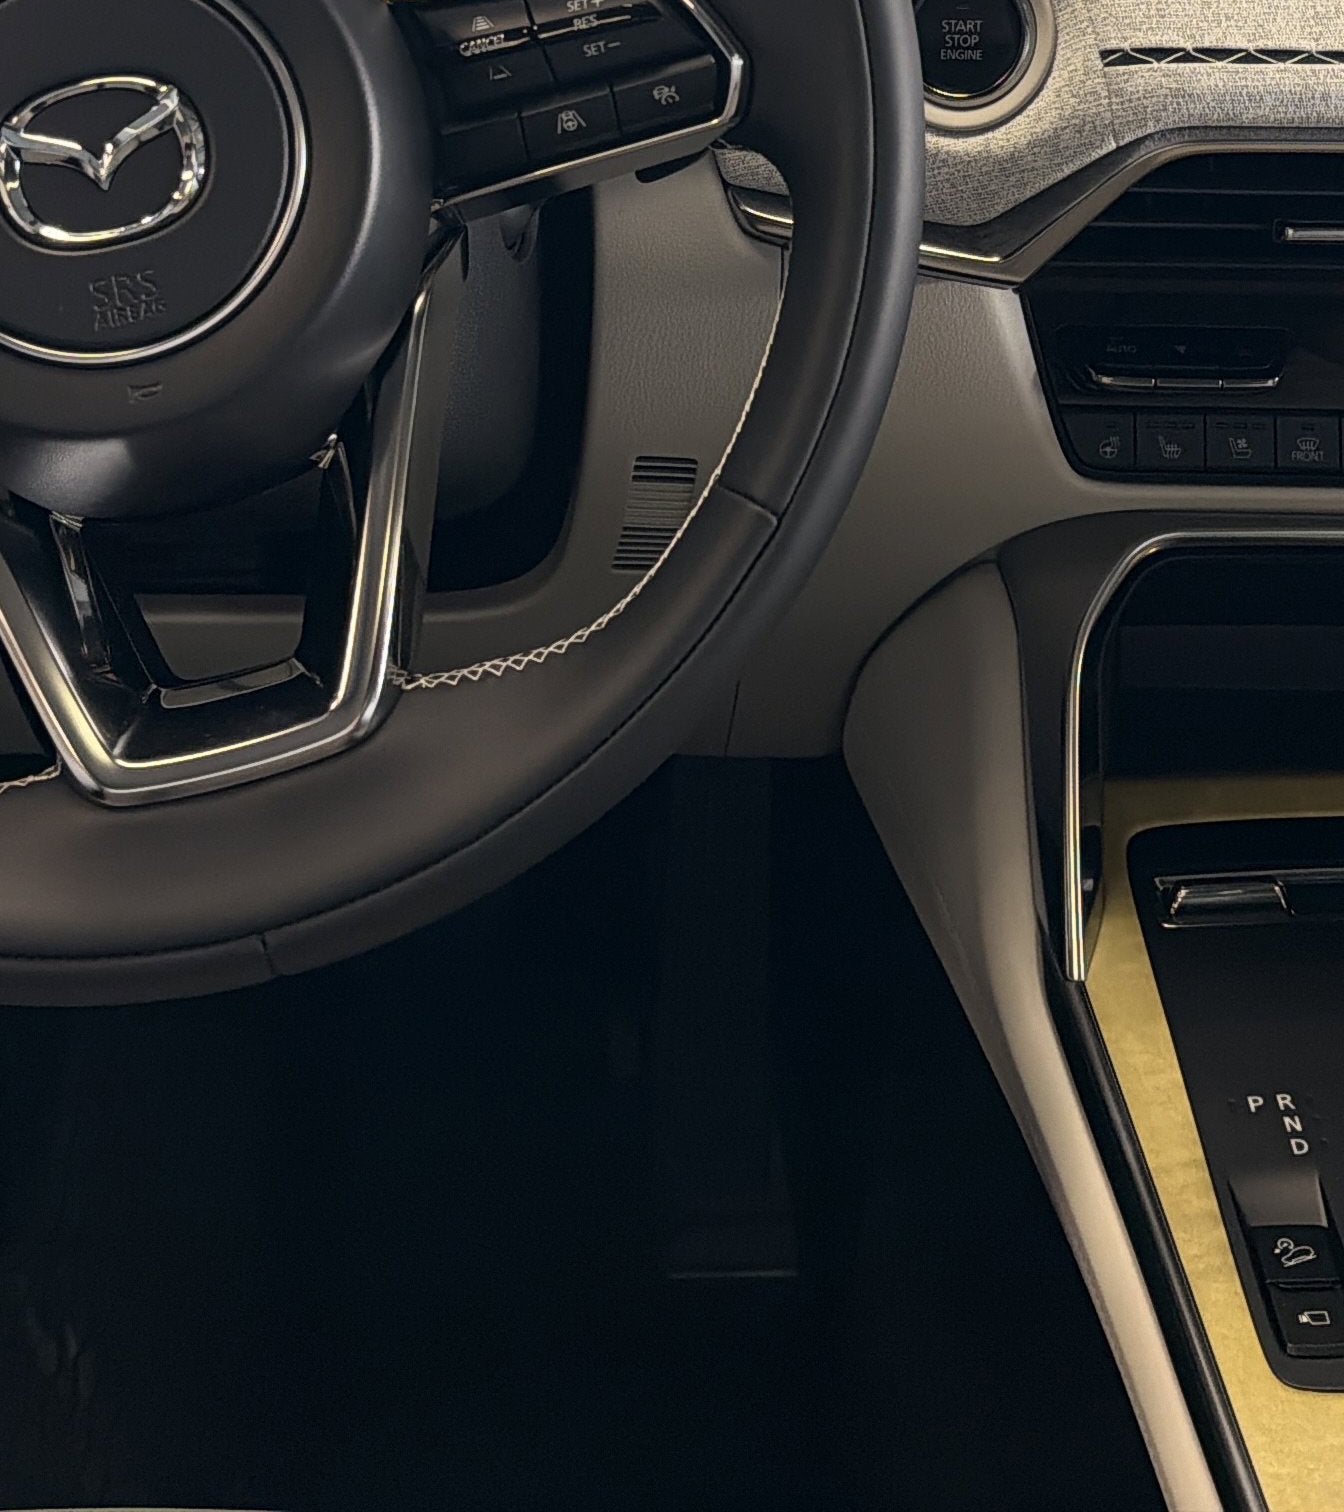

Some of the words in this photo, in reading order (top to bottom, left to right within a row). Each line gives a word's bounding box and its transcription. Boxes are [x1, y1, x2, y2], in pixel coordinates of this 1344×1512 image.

[573, 14, 599, 30] RES
[941, 20, 983, 32] START
[459, 34, 505, 56] CANCEL
[945, 34, 979, 47] STOP
[940, 49, 983, 60] ENGINE
[89, 270, 156, 310] SRS
[1291, 450, 1325, 462] FRONT
[1248, 1095, 1264, 1113] P
[1277, 1094, 1296, 1111] R
[1284, 1115, 1303, 1133] N
[1291, 1138, 1310, 1156] D
